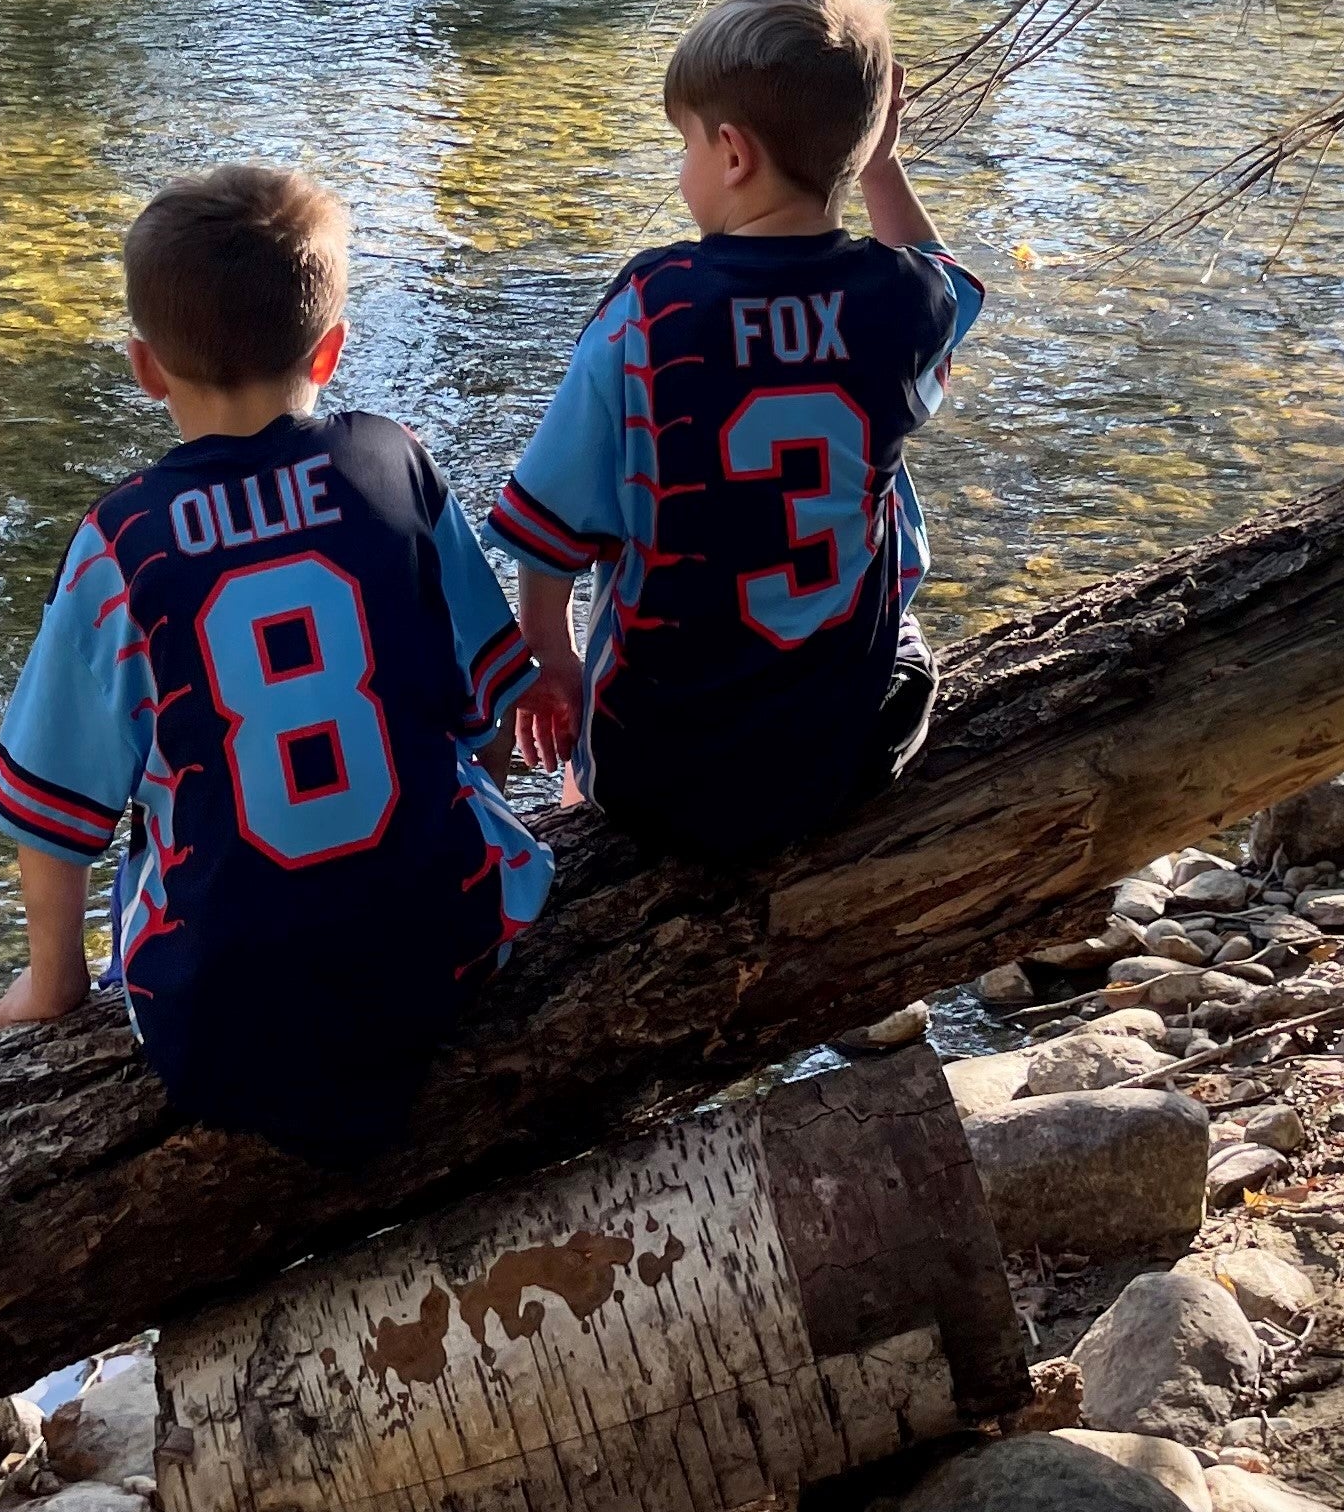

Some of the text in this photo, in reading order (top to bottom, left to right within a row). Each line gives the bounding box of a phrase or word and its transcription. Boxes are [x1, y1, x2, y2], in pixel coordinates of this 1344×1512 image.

[730, 291, 849, 367] FOX
[169, 453, 342, 555] OLLIE
[719, 384, 875, 650] 3
[194, 550, 400, 870] 8
